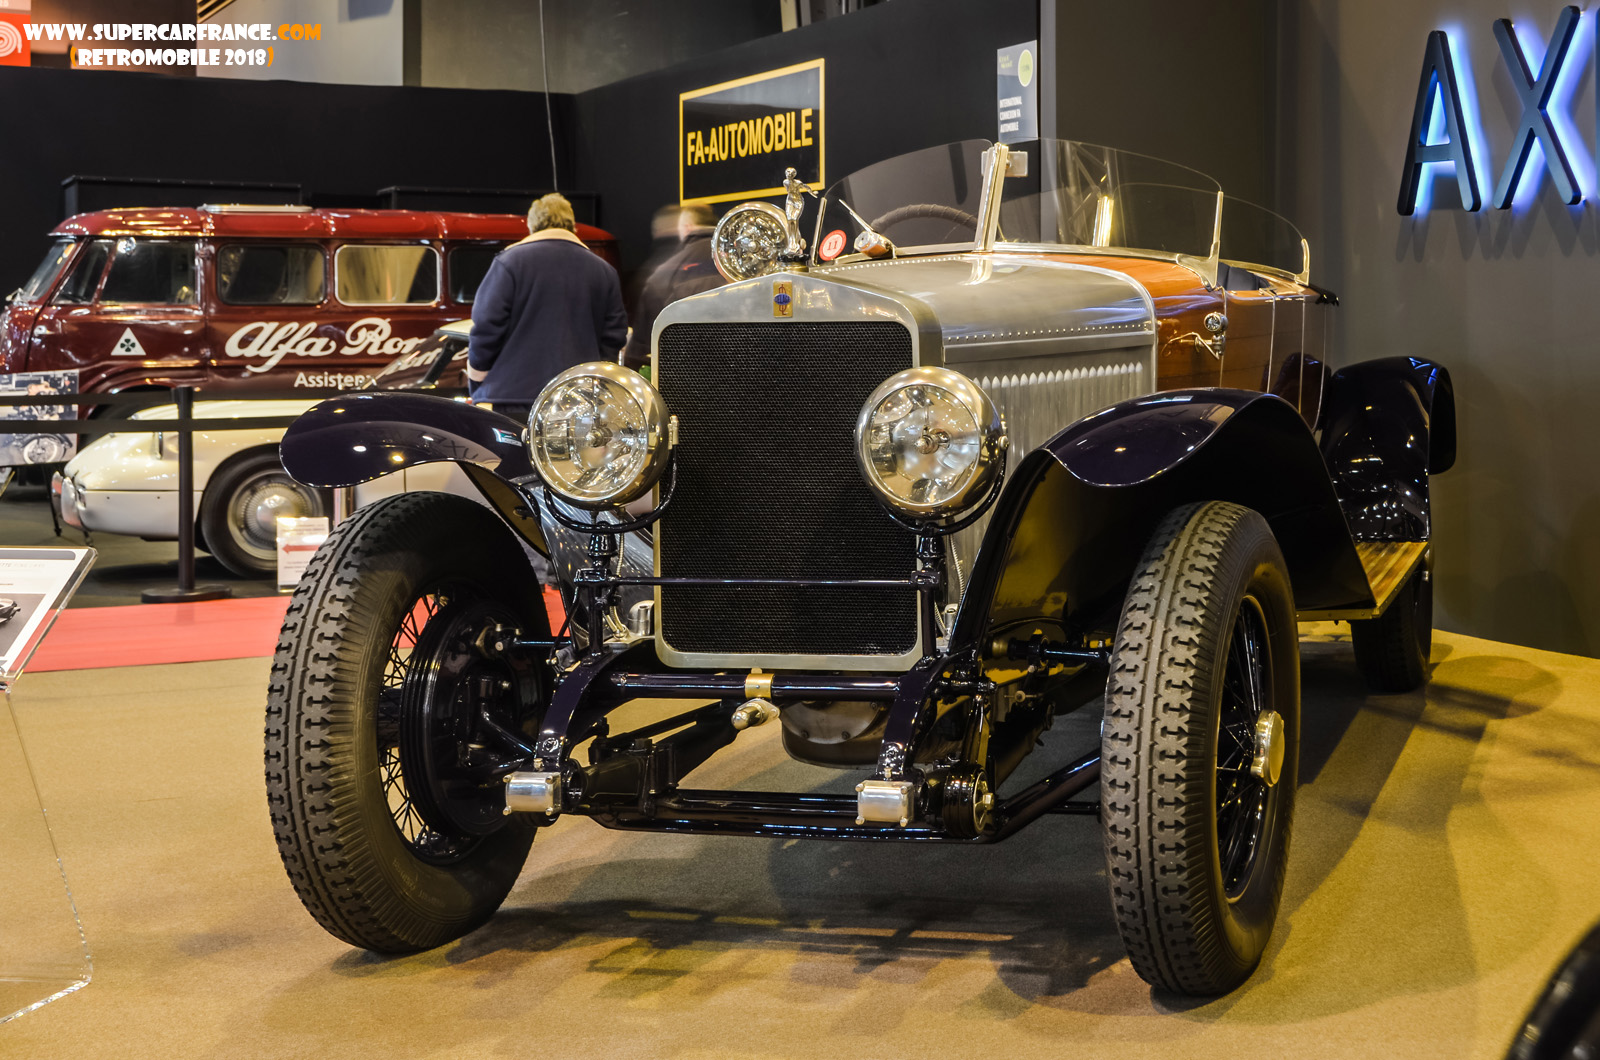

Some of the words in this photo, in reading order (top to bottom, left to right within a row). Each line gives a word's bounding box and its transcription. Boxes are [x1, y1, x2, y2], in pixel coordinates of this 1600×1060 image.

[687, 108, 813, 166] FA-AUTOMOBILE
[1397, 5, 1600, 216] AX
[225, 321, 336, 373] Alfa
[294, 371, 371, 387] Assisten
